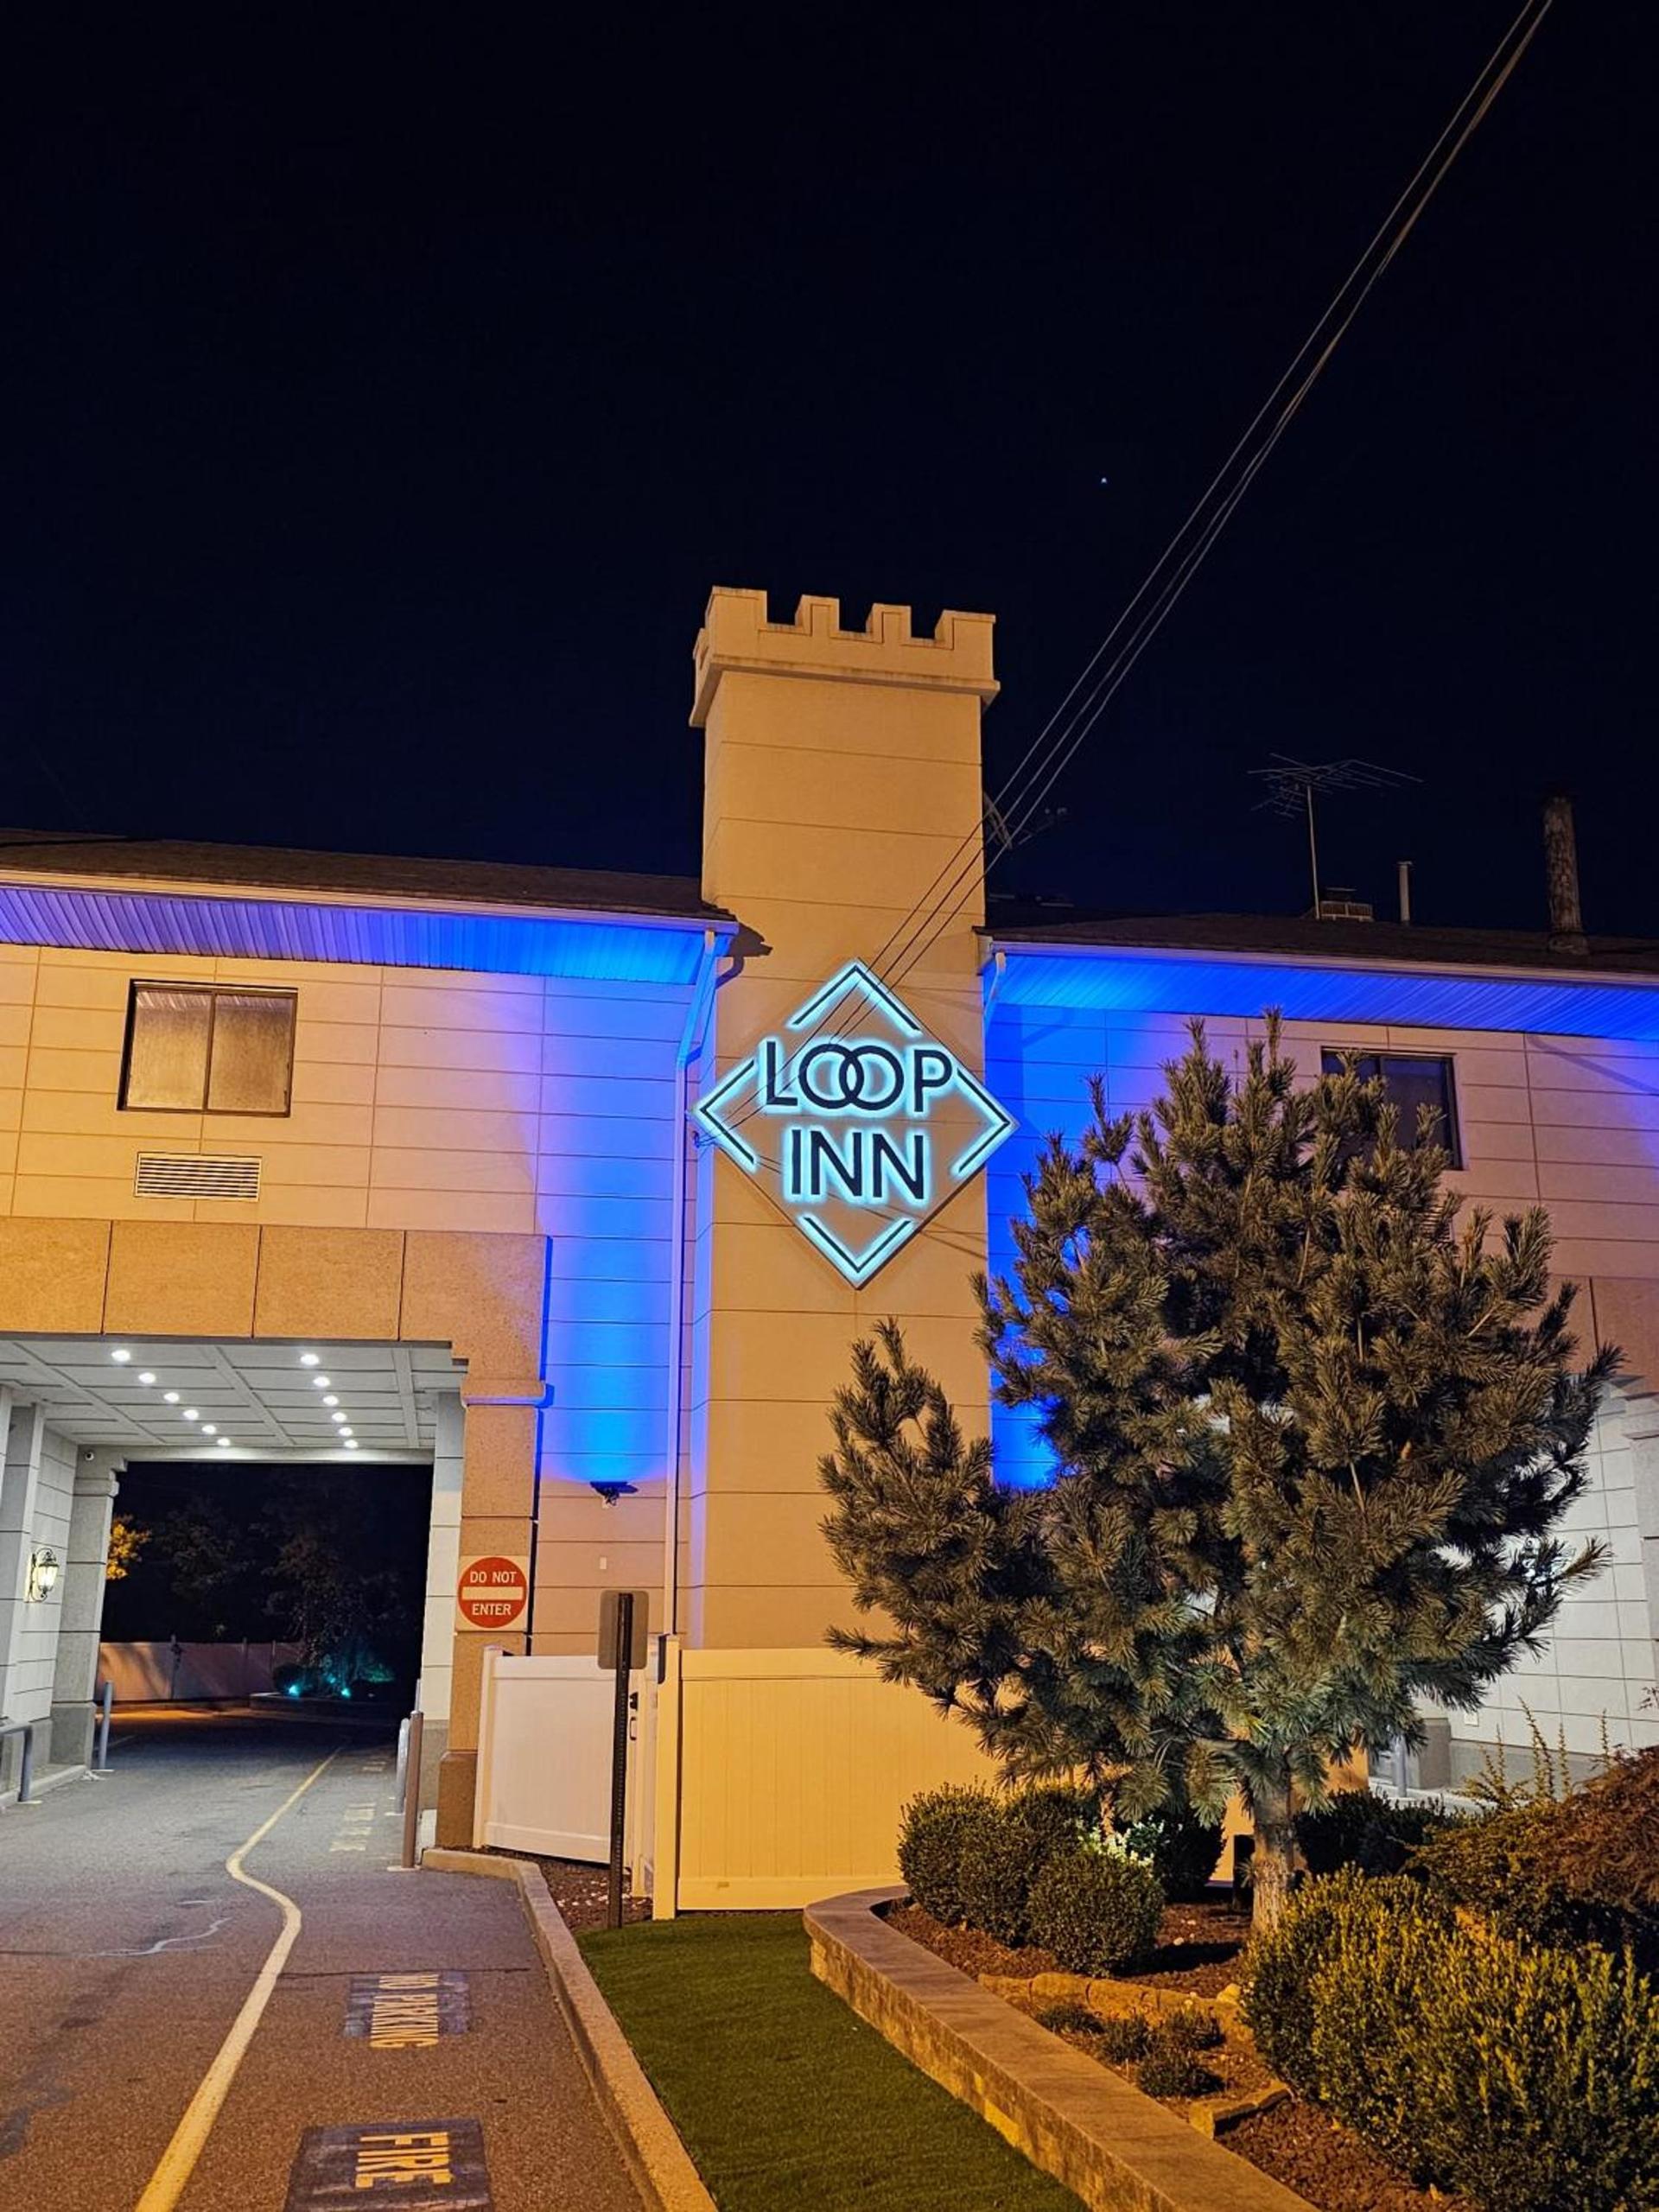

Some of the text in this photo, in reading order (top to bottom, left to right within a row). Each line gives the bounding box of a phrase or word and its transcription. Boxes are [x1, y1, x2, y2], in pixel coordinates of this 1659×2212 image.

[766, 1040, 952, 1113] LOOP
[791, 1128, 925, 1200] INN
[469, 1571, 517, 1584] DO NOT
[472, 1604, 512, 1616] ENTER
[370, 1974, 440, 2048] NO PARKING
[355, 2132, 453, 2188] FIRE
